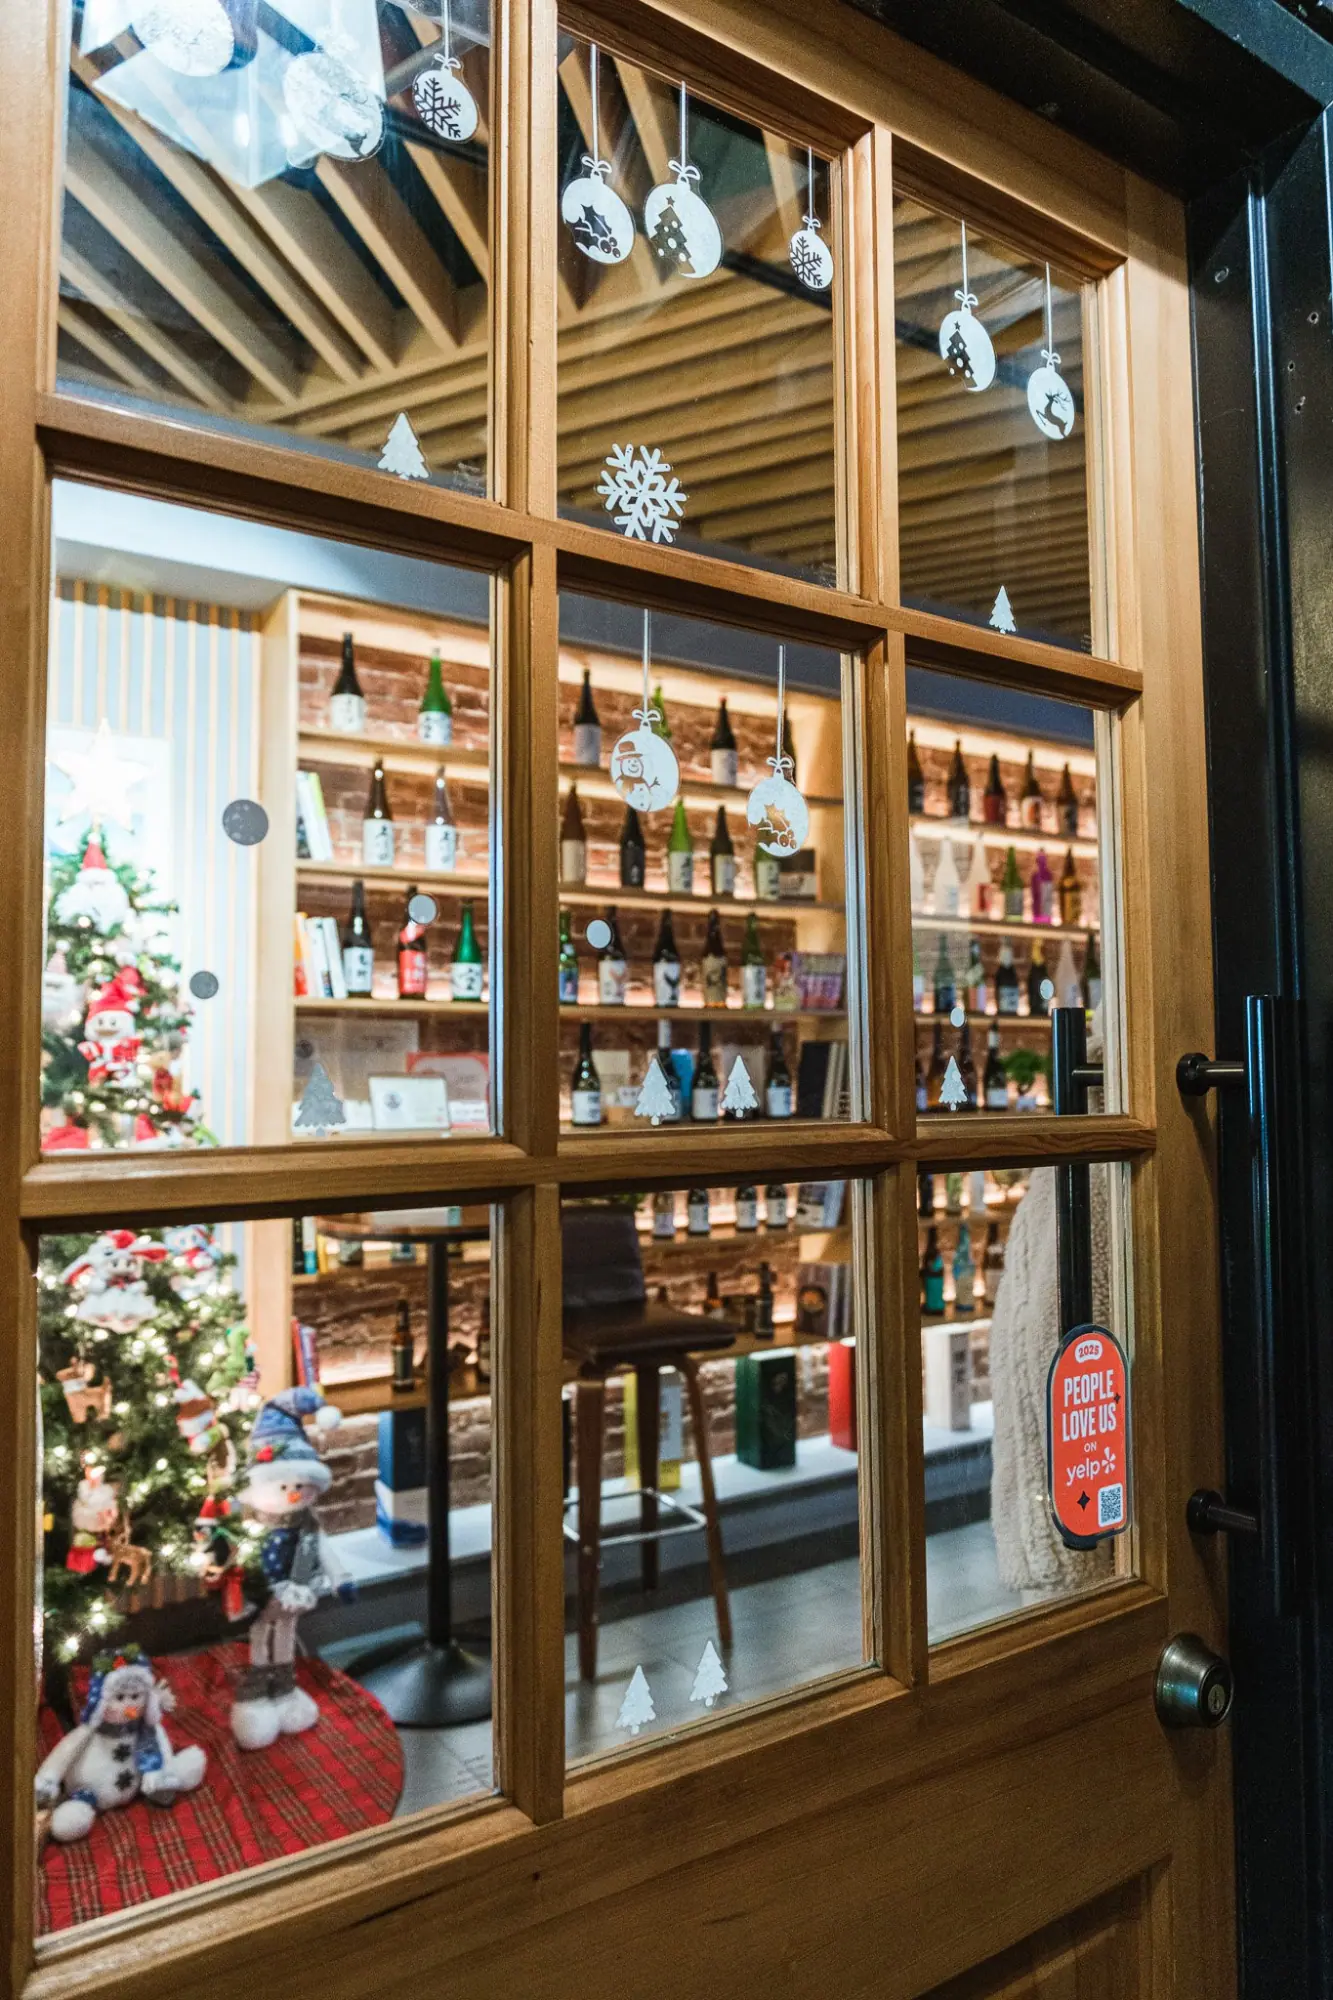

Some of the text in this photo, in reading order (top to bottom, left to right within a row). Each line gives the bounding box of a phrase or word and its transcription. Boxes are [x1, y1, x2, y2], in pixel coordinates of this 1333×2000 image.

[1078, 1346, 1099, 1358] 2025
[1064, 1369, 1114, 1407] PEOPLE
[1062, 1402, 1117, 1442] LOVE US
[1084, 1442, 1097, 1453] ON
[1066, 1458, 1101, 1486] yelp
